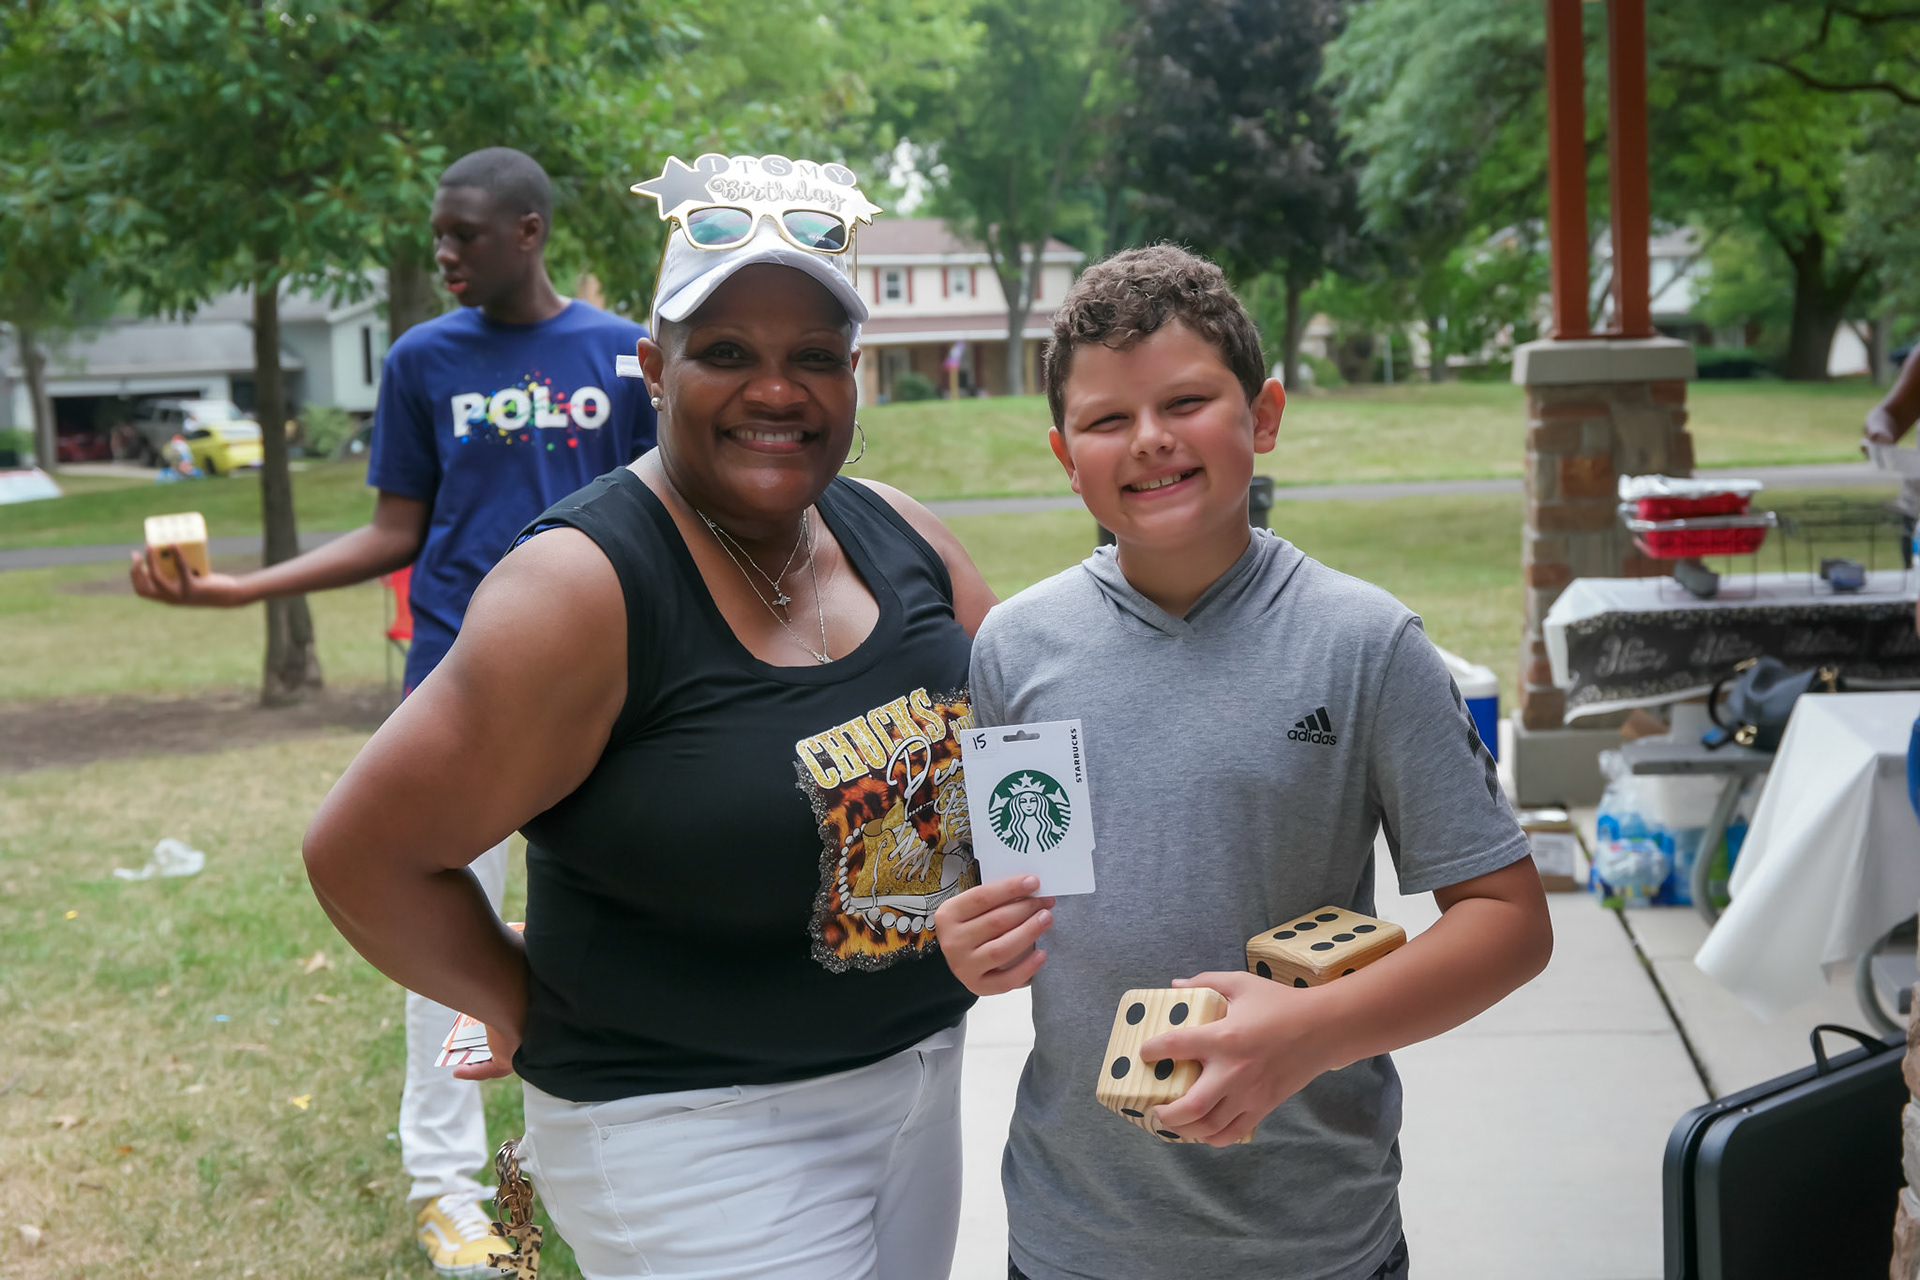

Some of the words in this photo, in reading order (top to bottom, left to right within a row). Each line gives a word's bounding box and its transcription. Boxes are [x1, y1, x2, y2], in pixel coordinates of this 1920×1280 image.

[800, 164, 847, 183] MY
[707, 177, 846, 212] Birthday
[451, 386, 611, 438] POLO
[796, 687, 947, 789] CHUCKS
[972, 733, 987, 750] 15
[1287, 728, 1337, 746] adidas
[1070, 728, 1082, 783] STARBUCKS
